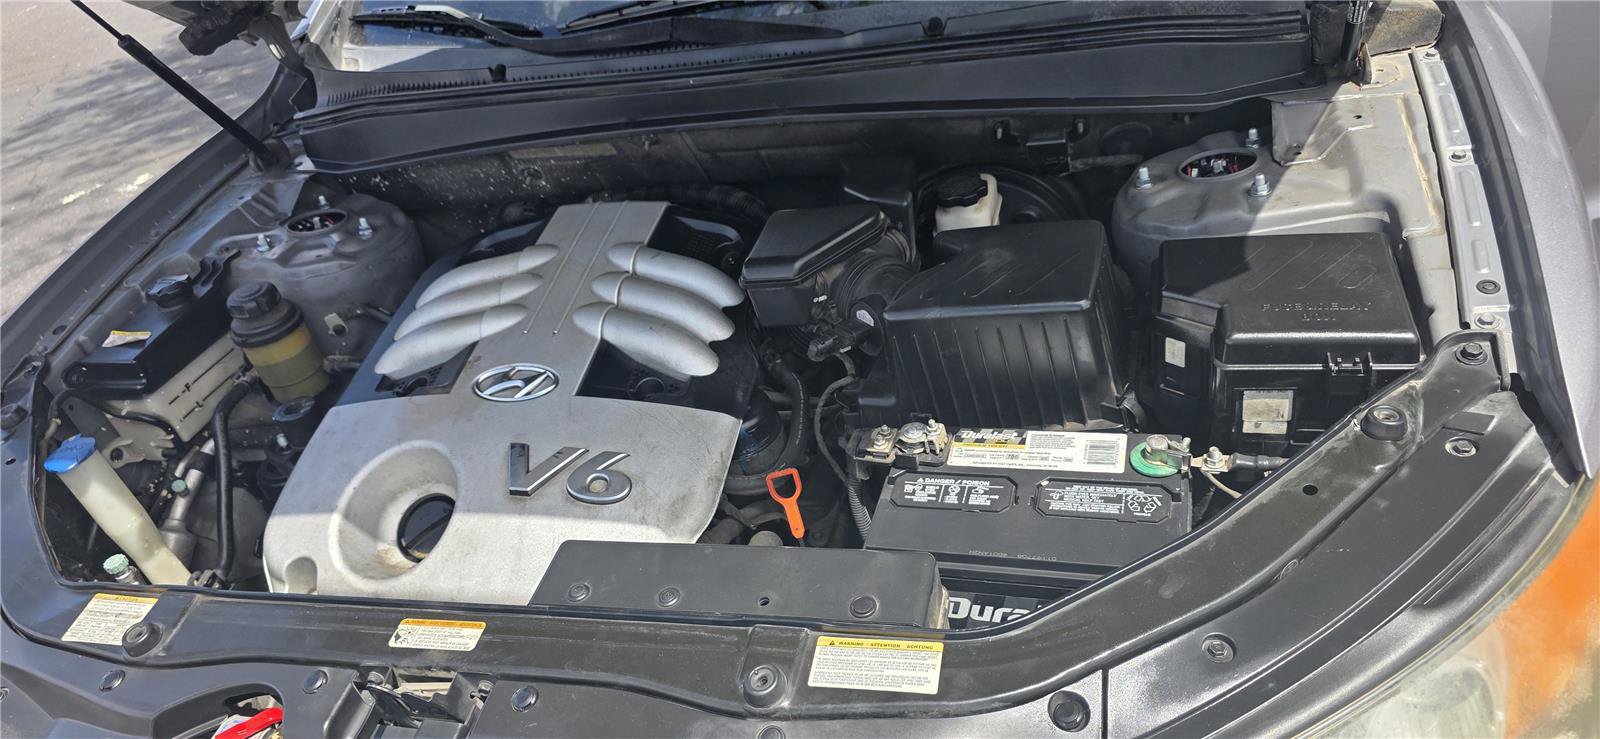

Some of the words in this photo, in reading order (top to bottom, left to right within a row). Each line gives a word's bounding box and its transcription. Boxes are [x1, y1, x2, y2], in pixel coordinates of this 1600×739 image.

[960, 430, 1019, 440] Duralast
[509, 442, 632, 505] V6
[947, 597, 1042, 623] Dura
